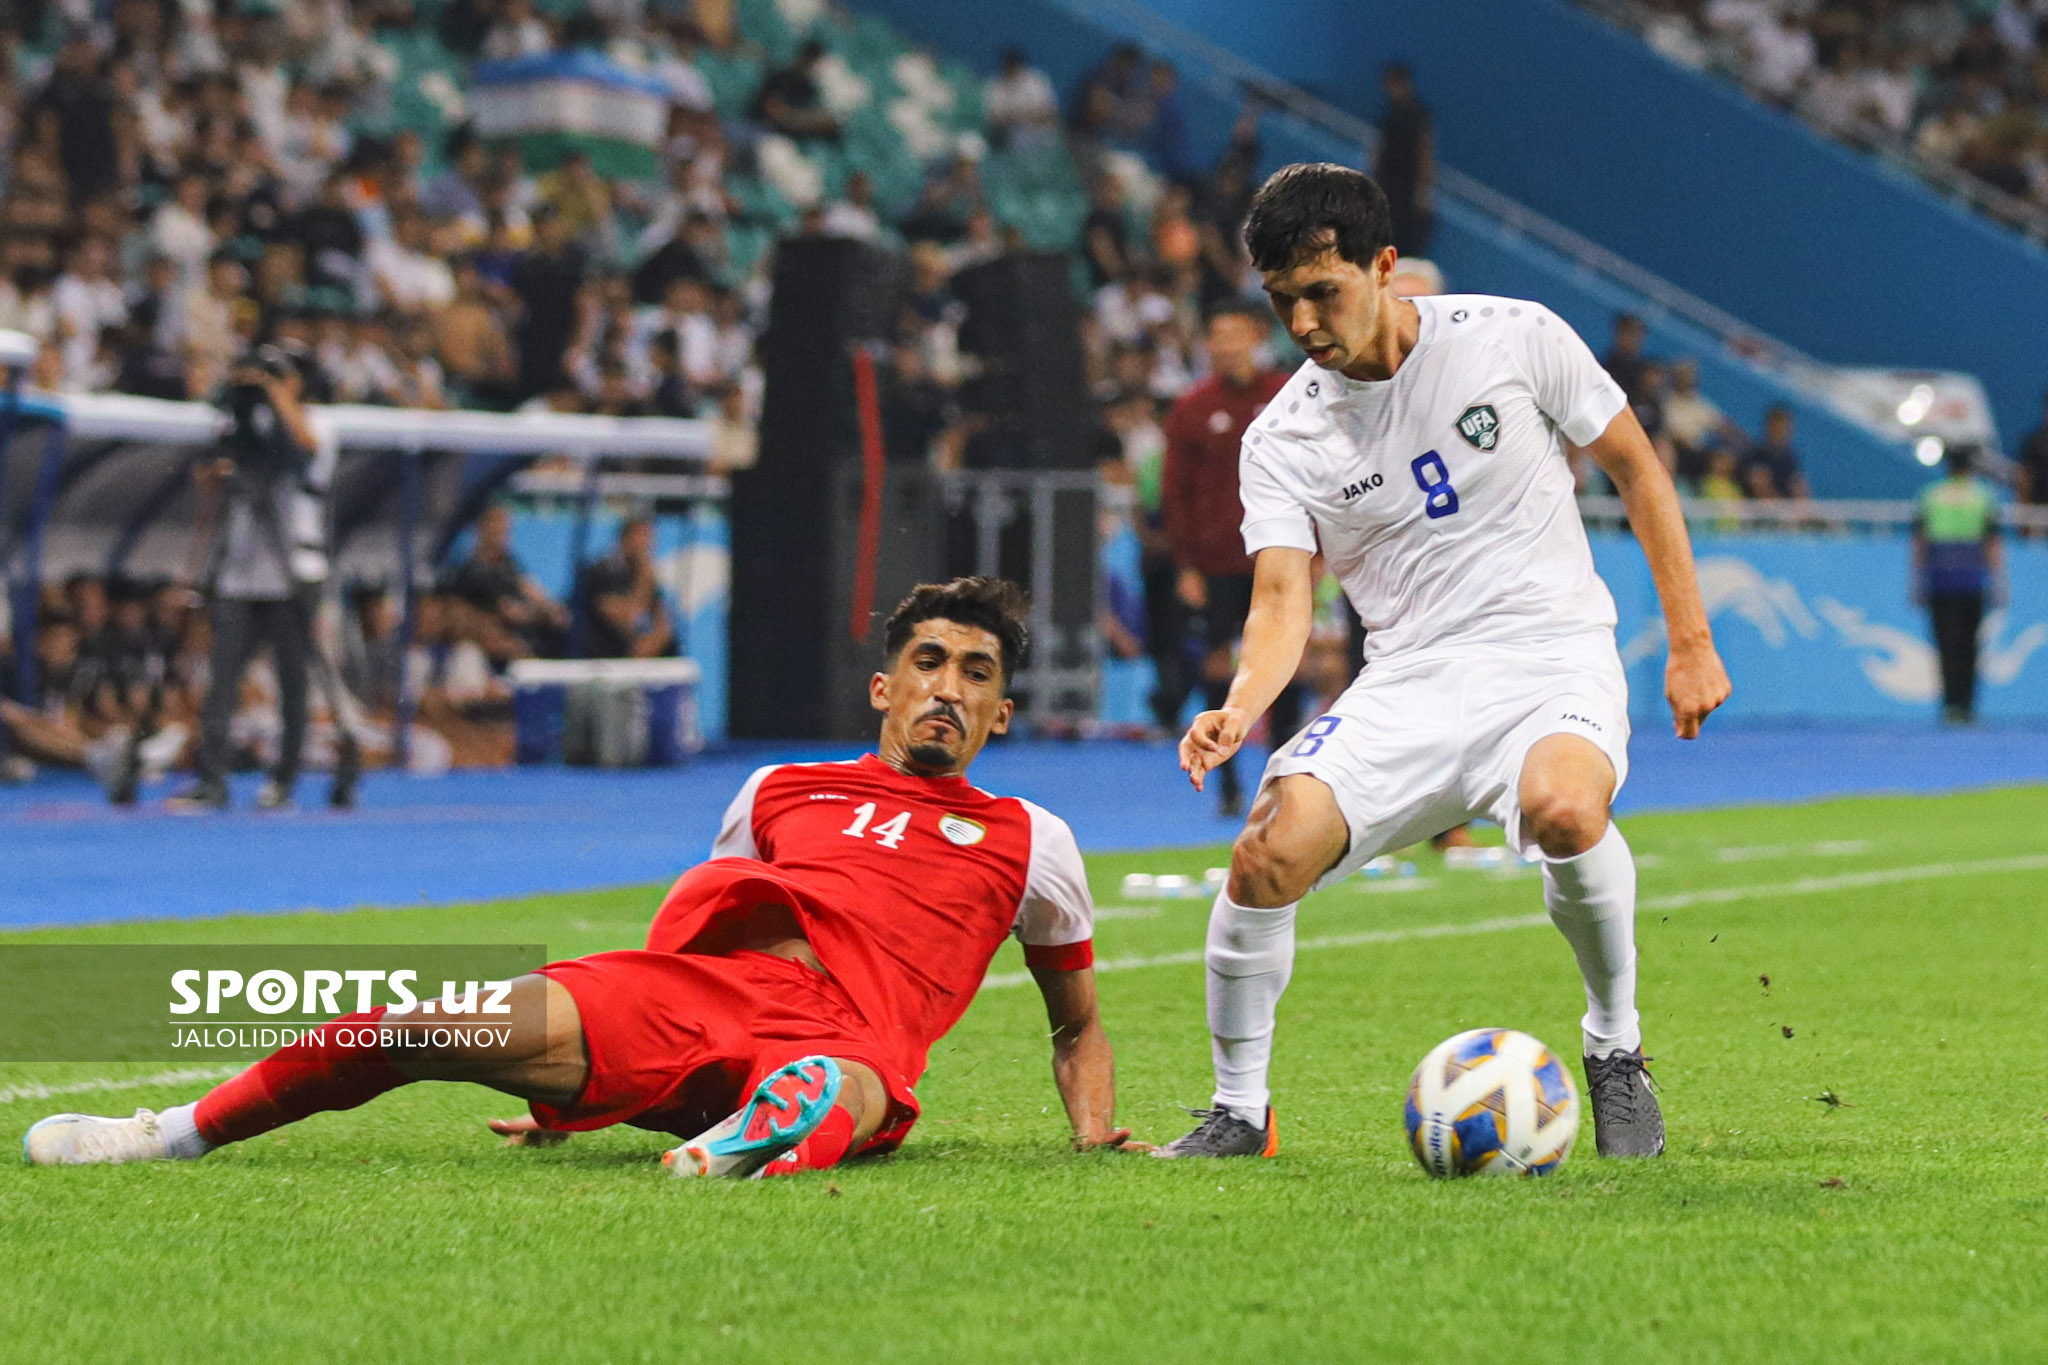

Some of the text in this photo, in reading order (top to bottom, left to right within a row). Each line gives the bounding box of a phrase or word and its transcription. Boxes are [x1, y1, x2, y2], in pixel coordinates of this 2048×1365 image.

[1461, 410, 1496, 437] UFA
[1342, 473, 1384, 500] JAKO
[1411, 449, 1459, 519] 8
[1292, 715, 1342, 758] 8
[842, 802, 912, 849] 14
[1429, 1112, 1447, 1176] molten
